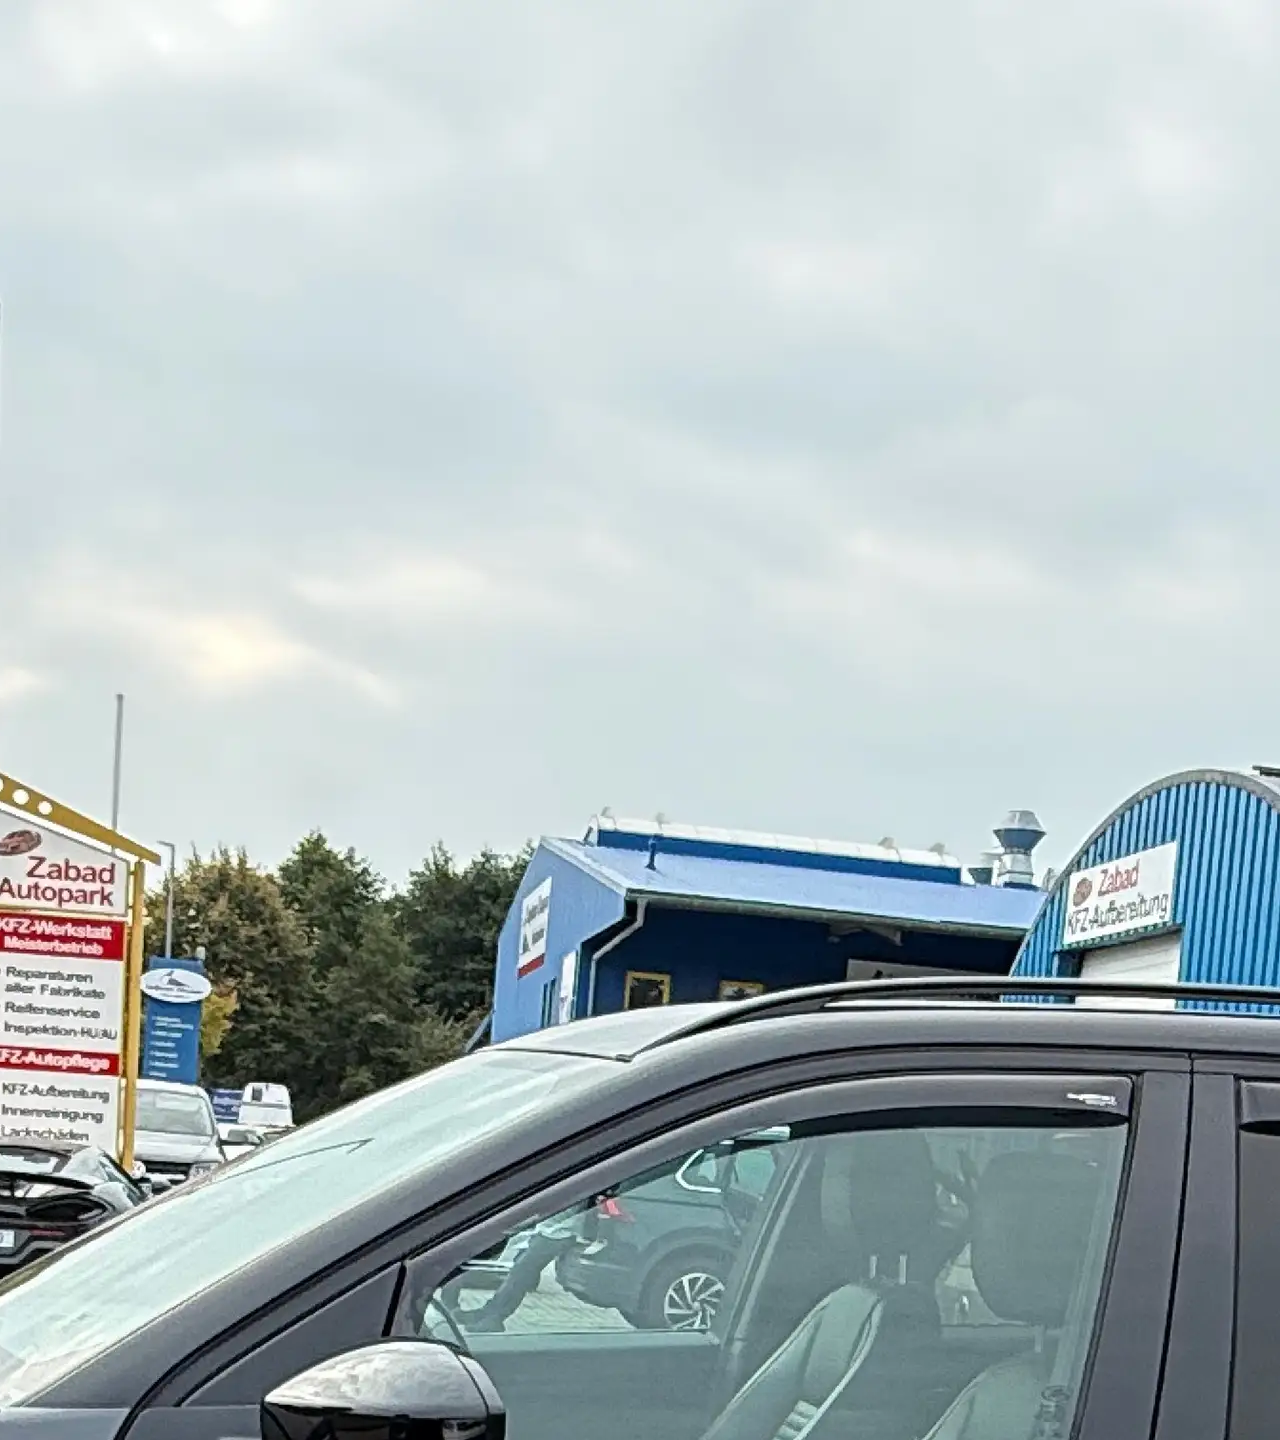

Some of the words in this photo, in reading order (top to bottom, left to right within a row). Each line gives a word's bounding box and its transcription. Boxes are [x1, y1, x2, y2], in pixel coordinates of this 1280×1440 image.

[26, 856, 116, 886] Zabad
[1098, 858, 1140, 896] Zabad
[1067, 892, 1169, 934] KFZ-Aufbereitung
[4, 935, 103, 956] Meisterbetrieb
[6, 966, 93, 984] Reparaturen
[5, 982, 36, 994] aller
[40, 984, 106, 999] Fabrikate
[5, 1001, 100, 1019] Reifenservice
[2, 1082, 110, 1104] KFZ-Aufbereitung
[1, 1104, 104, 1124] Innenreinigung
